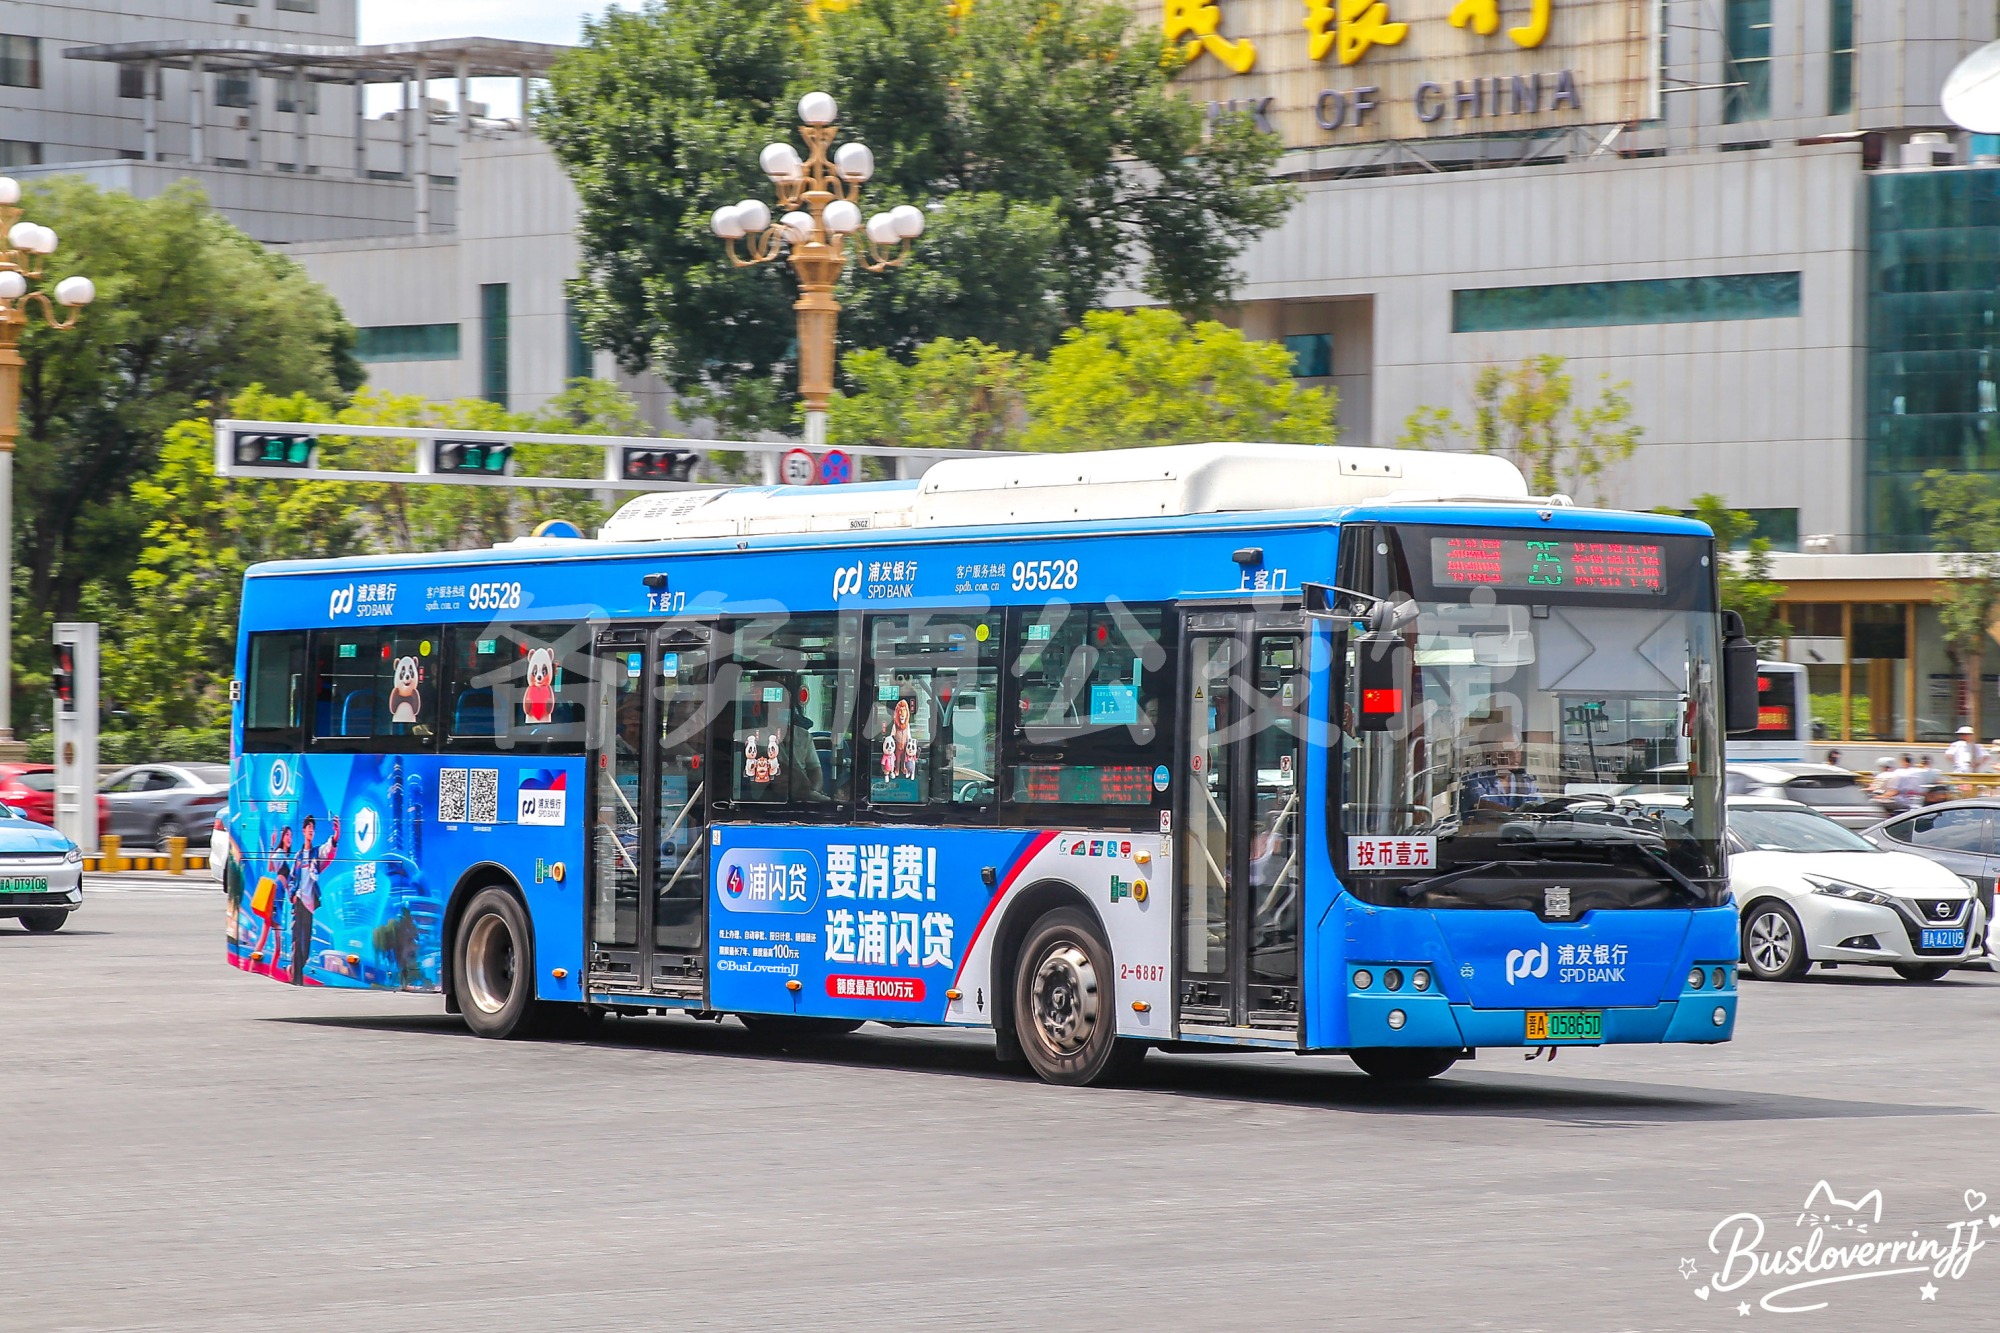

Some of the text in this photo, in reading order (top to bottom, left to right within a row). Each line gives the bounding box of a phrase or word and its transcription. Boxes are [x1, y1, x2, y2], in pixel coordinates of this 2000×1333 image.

[1315, 86, 1379, 130] OF
[1414, 69, 1582, 123] CHINA
[850, 520, 868, 529] SONGZ
[868, 560, 918, 583] 浦发银行
[956, 563, 1006, 579] 客户服务热线
[1012, 559, 1079, 592] 95528
[1235, 568, 1287, 592] 上客门
[357, 582, 397, 602] 浦发银行
[468, 581, 522, 610] 95528
[646, 591, 686, 612] 下客门
[868, 583, 914, 599] SPD BANK
[356, 603, 393, 618] SPD BANK
[1357, 841, 1429, 866] 投币壹元
[748, 863, 807, 902] 浦闪贷
[826, 844, 937, 902] 要消费!
[825, 909, 954, 969] 选浦闪贷
[1557, 944, 1629, 966] 浦发银行
[1121, 964, 1164, 981] 2-6887
[1559, 967, 1626, 983] SPD BANK
[836, 977, 914, 999] 额度最高100万元
[1551, 1015, 1601, 1035] 05865D
